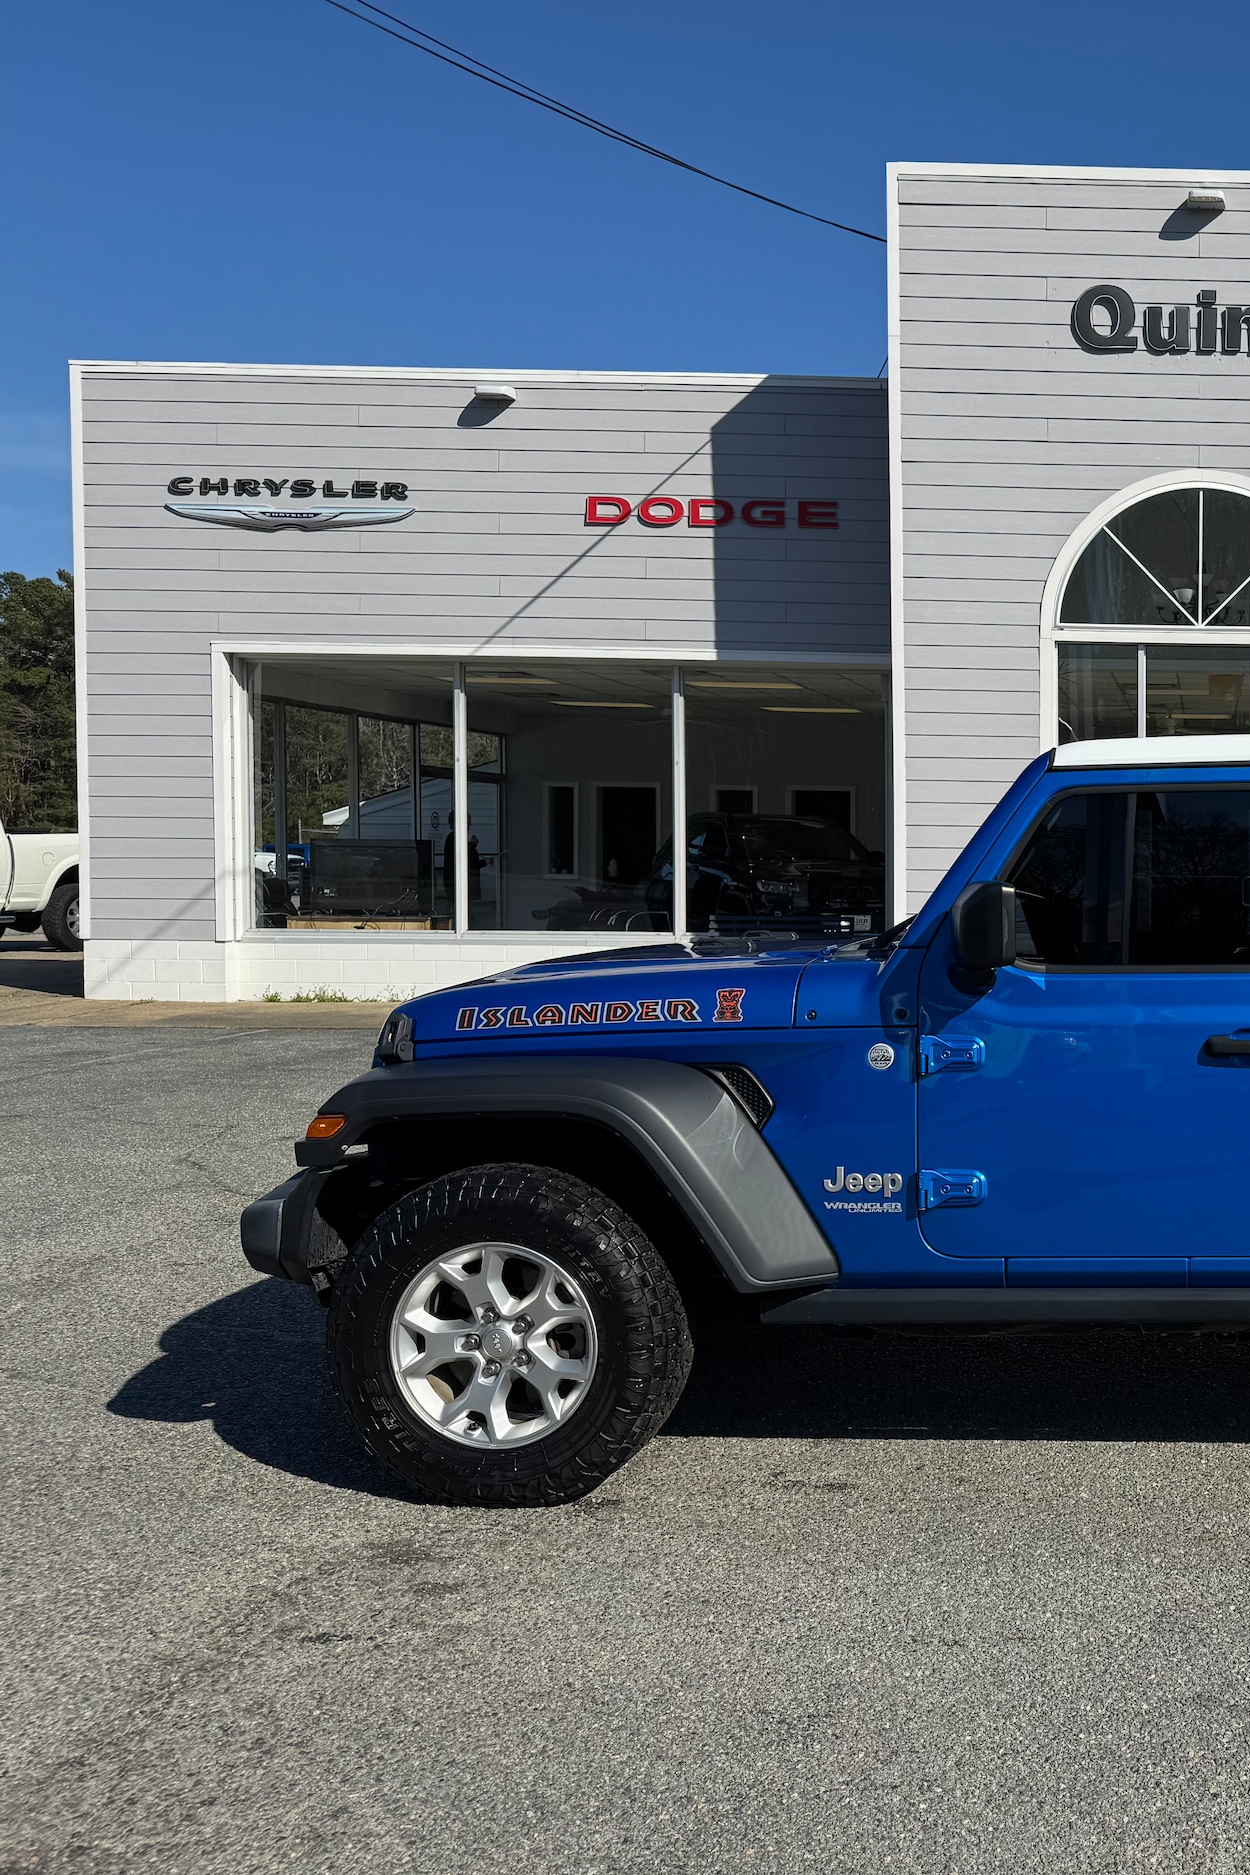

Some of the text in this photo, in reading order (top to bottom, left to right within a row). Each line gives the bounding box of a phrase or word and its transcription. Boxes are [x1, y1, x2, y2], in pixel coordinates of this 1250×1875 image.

[168, 477, 408, 501] CHRYSLER
[584, 495, 840, 529] DODGE
[455, 999, 702, 1031] ISLANDER
[823, 1166, 903, 1198] Jeep
[823, 1201, 902, 1209] WRANGLER
